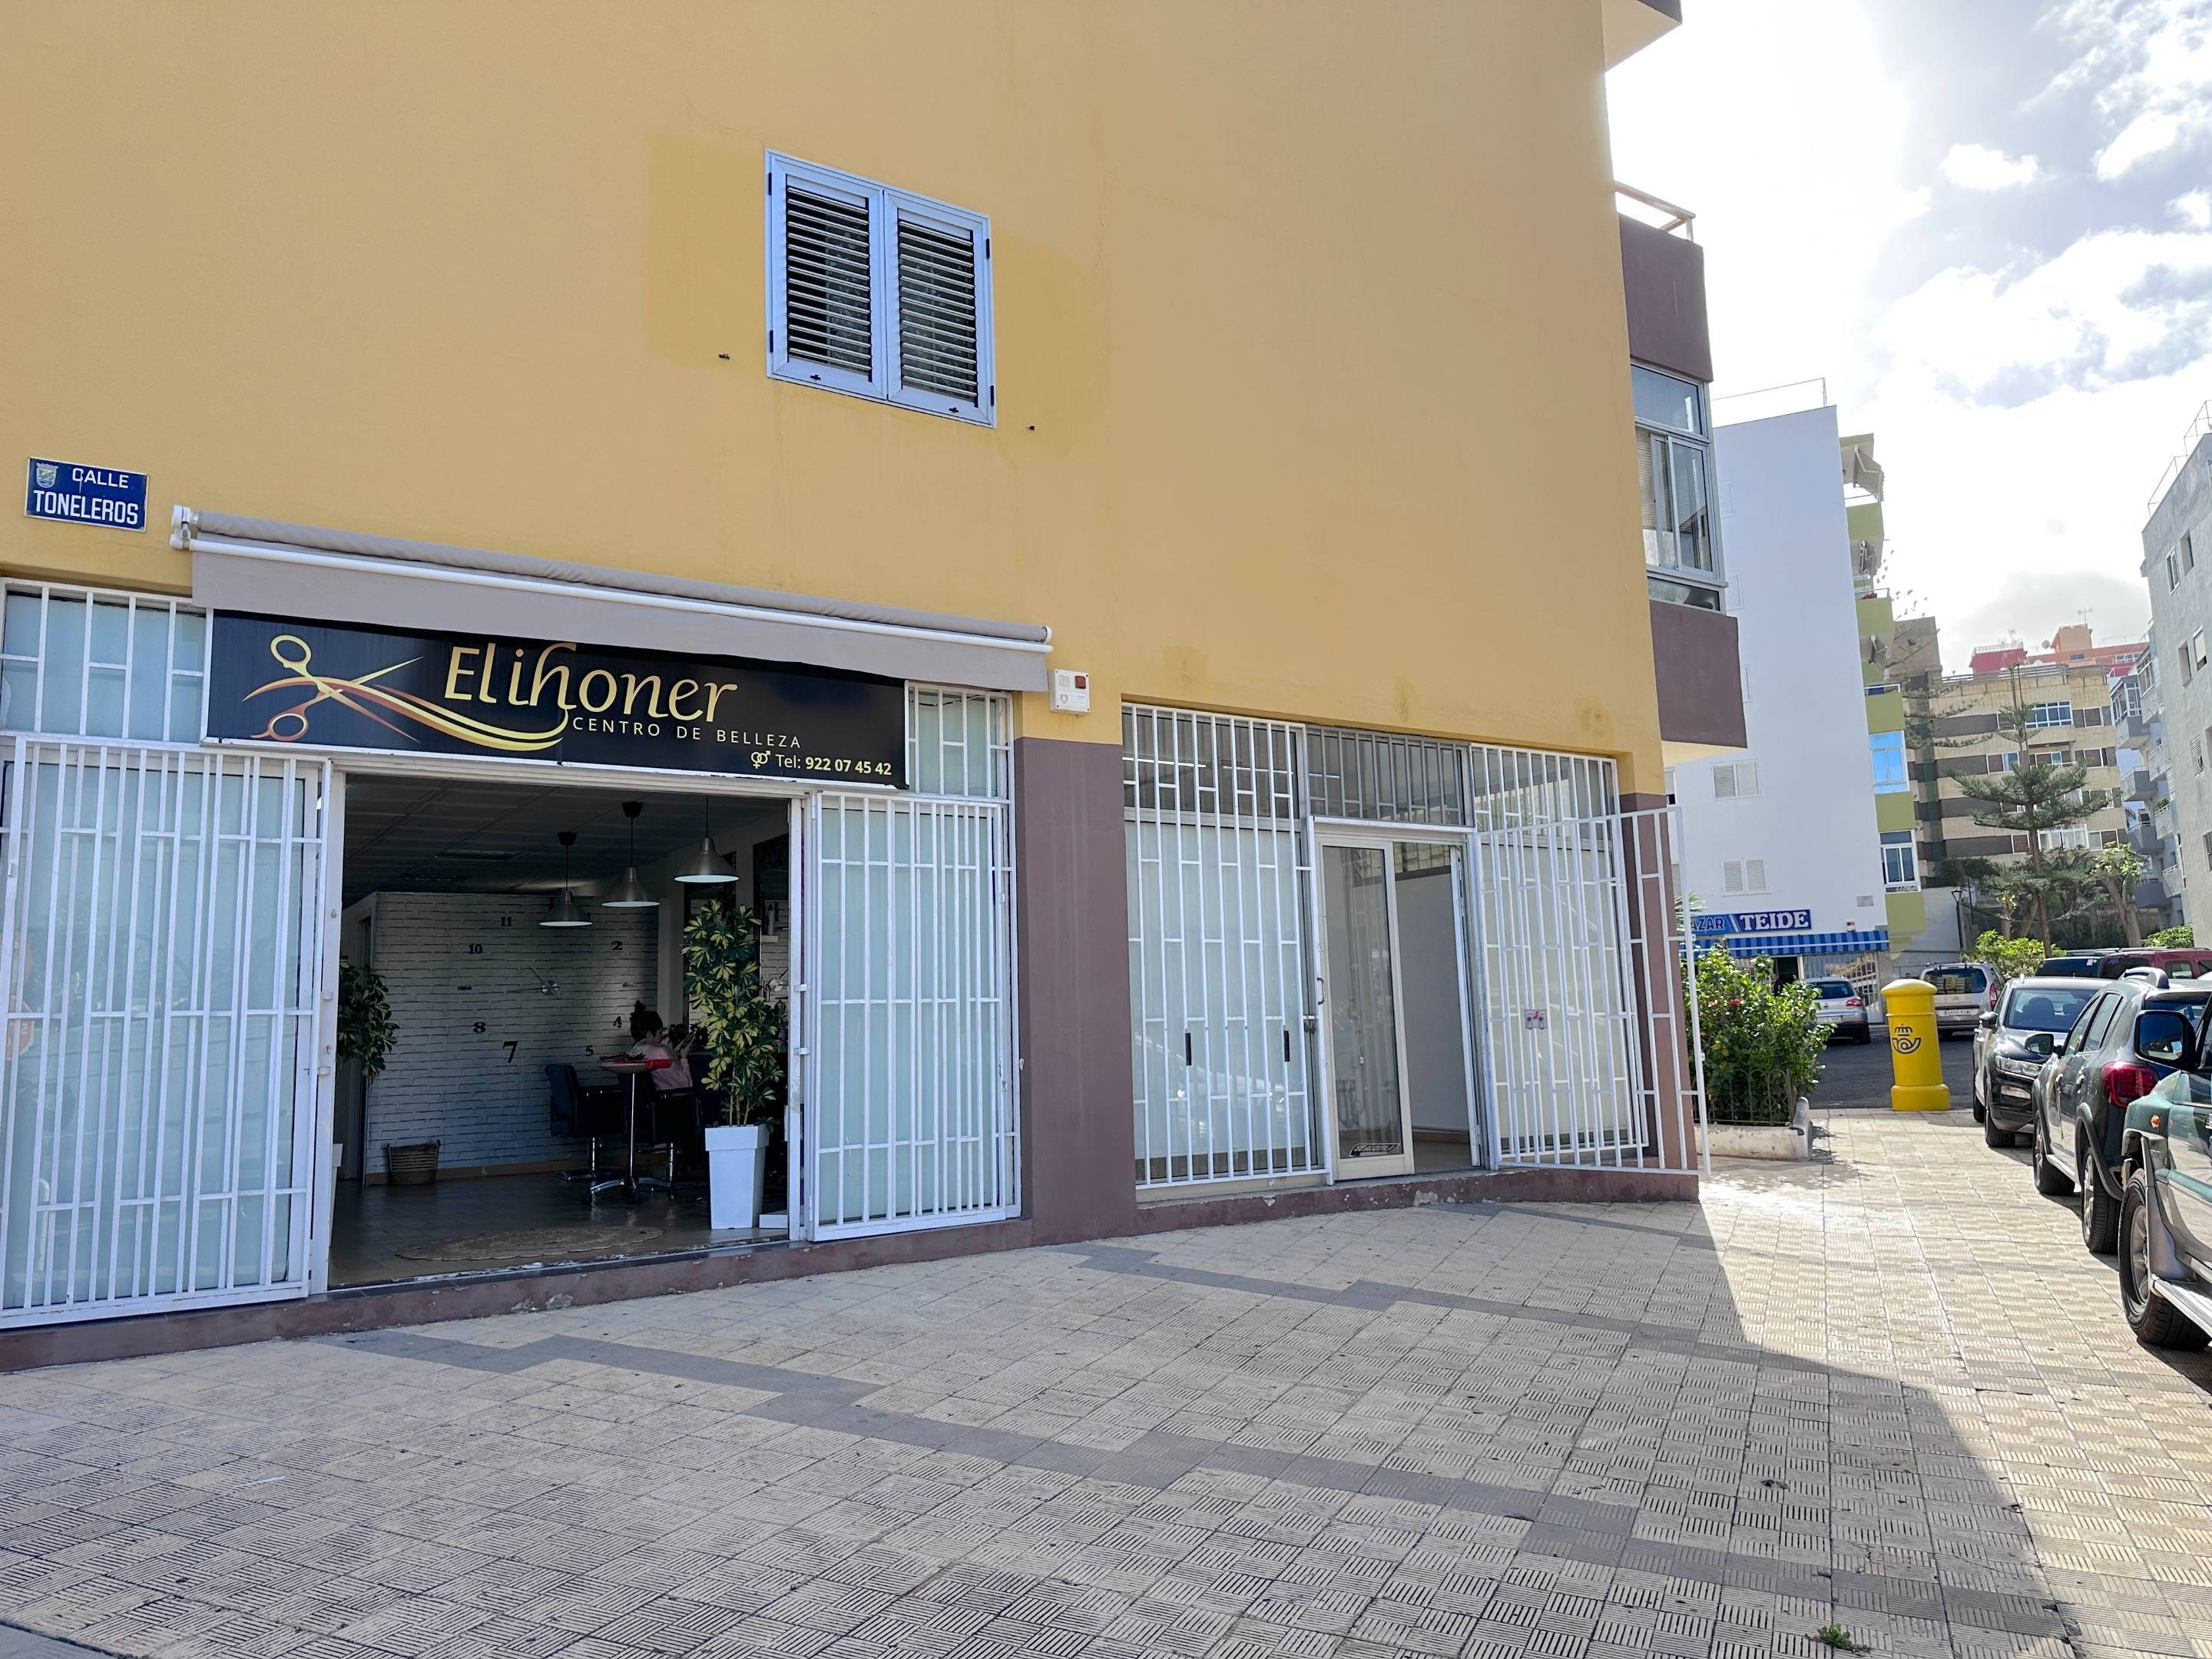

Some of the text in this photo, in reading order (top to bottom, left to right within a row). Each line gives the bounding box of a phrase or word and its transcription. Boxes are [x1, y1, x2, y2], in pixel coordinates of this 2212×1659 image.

[71, 468, 129, 488] CALLE
[33, 489, 138, 525] TONELEROS
[444, 642, 738, 723] Elihoner
[573, 717, 801, 749] CENTRO DE BELLEZA
[775, 753, 892, 776] Tel: 922 07 45 42
[501, 916, 512, 926] 11
[1690, 910, 1809, 931] AZAR TEIDE
[469, 943, 483, 955] 10
[611, 940, 623, 951] 2
[473, 1022, 486, 1033] 8
[502, 1041, 518, 1063] 7
[585, 1045, 594, 1056] 5
